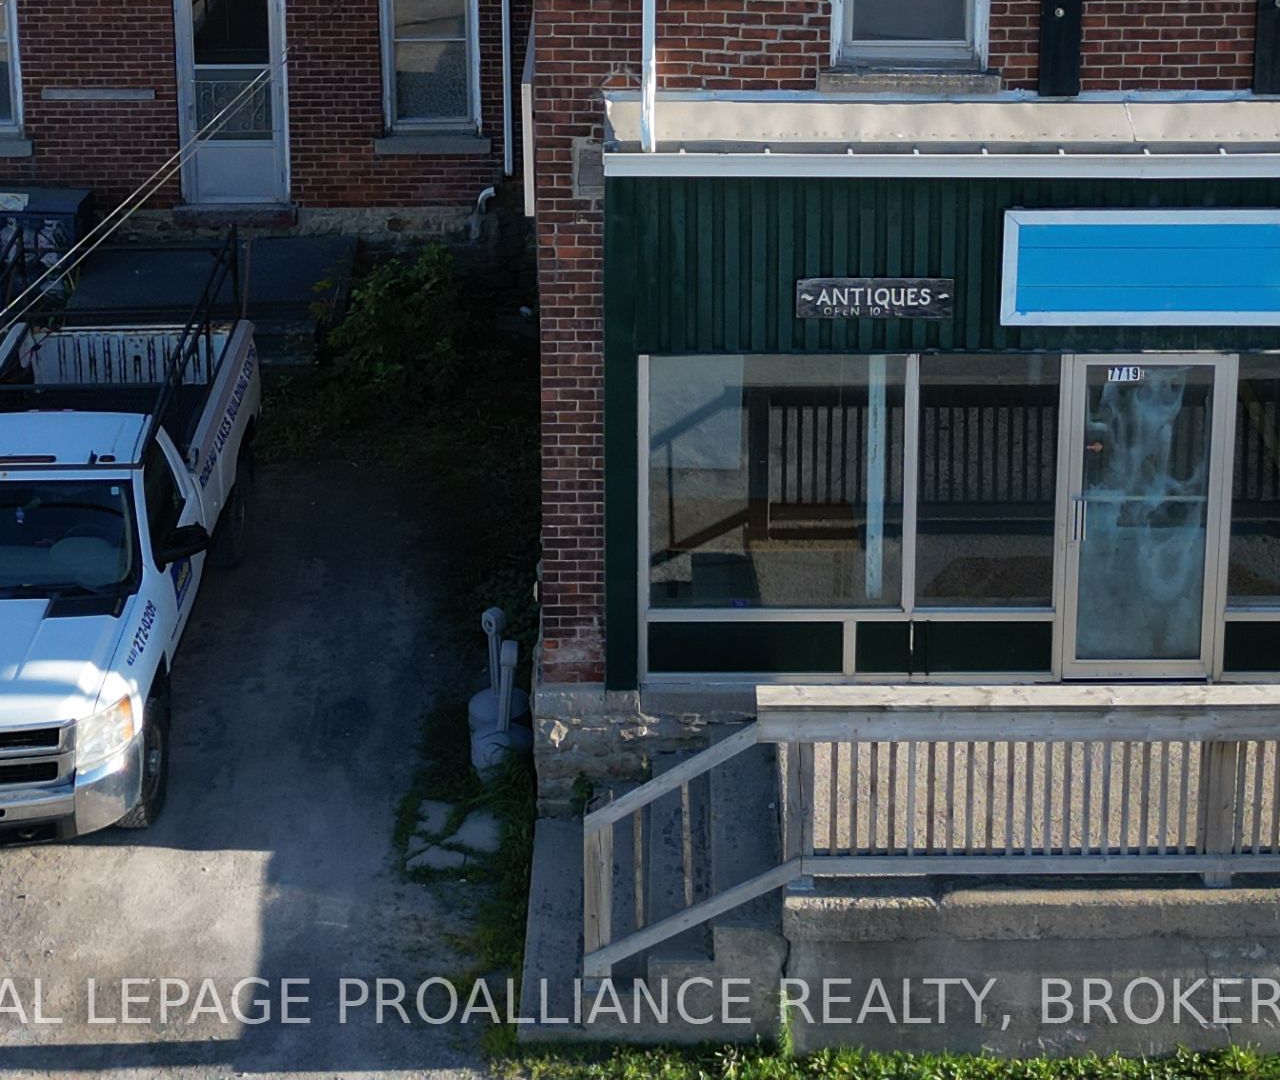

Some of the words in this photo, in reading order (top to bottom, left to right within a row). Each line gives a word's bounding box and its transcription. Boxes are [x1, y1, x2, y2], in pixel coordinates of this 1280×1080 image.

[816, 288, 931, 308] ANTIQUES
[1108, 367, 1139, 380] 7719
[214, 417, 233, 454] LAKES
